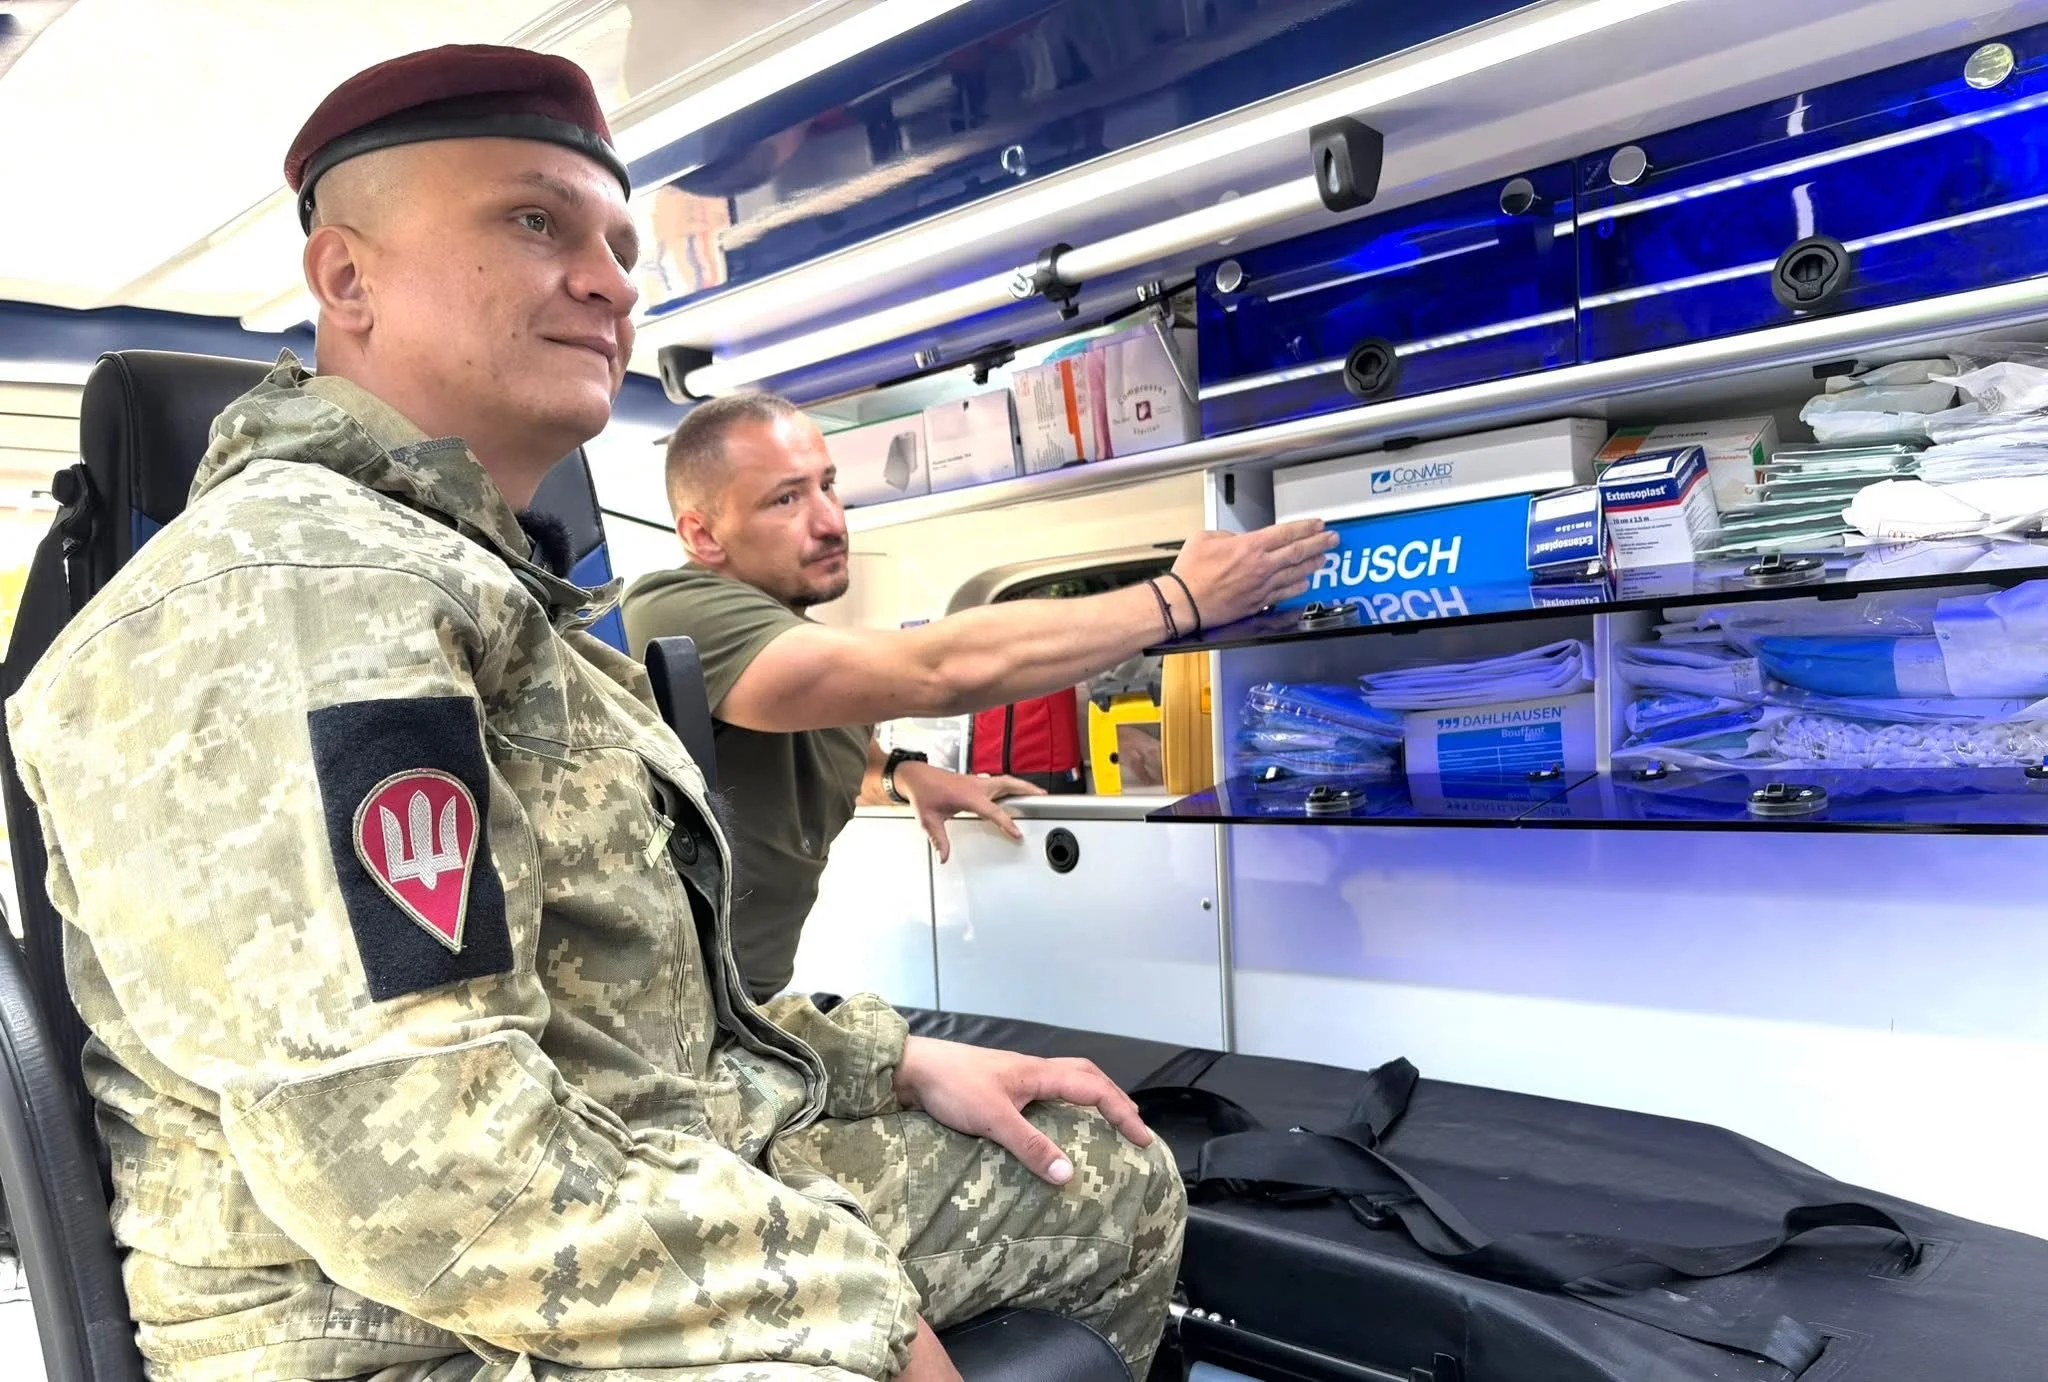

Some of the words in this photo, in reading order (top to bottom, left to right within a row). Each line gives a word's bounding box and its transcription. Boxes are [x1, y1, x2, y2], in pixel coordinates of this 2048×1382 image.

[1606, 485, 1667, 502] Extensoplast
[1312, 535, 1462, 590] RÜSCH
[1463, 706, 1561, 728] DAHLHAUSEN
